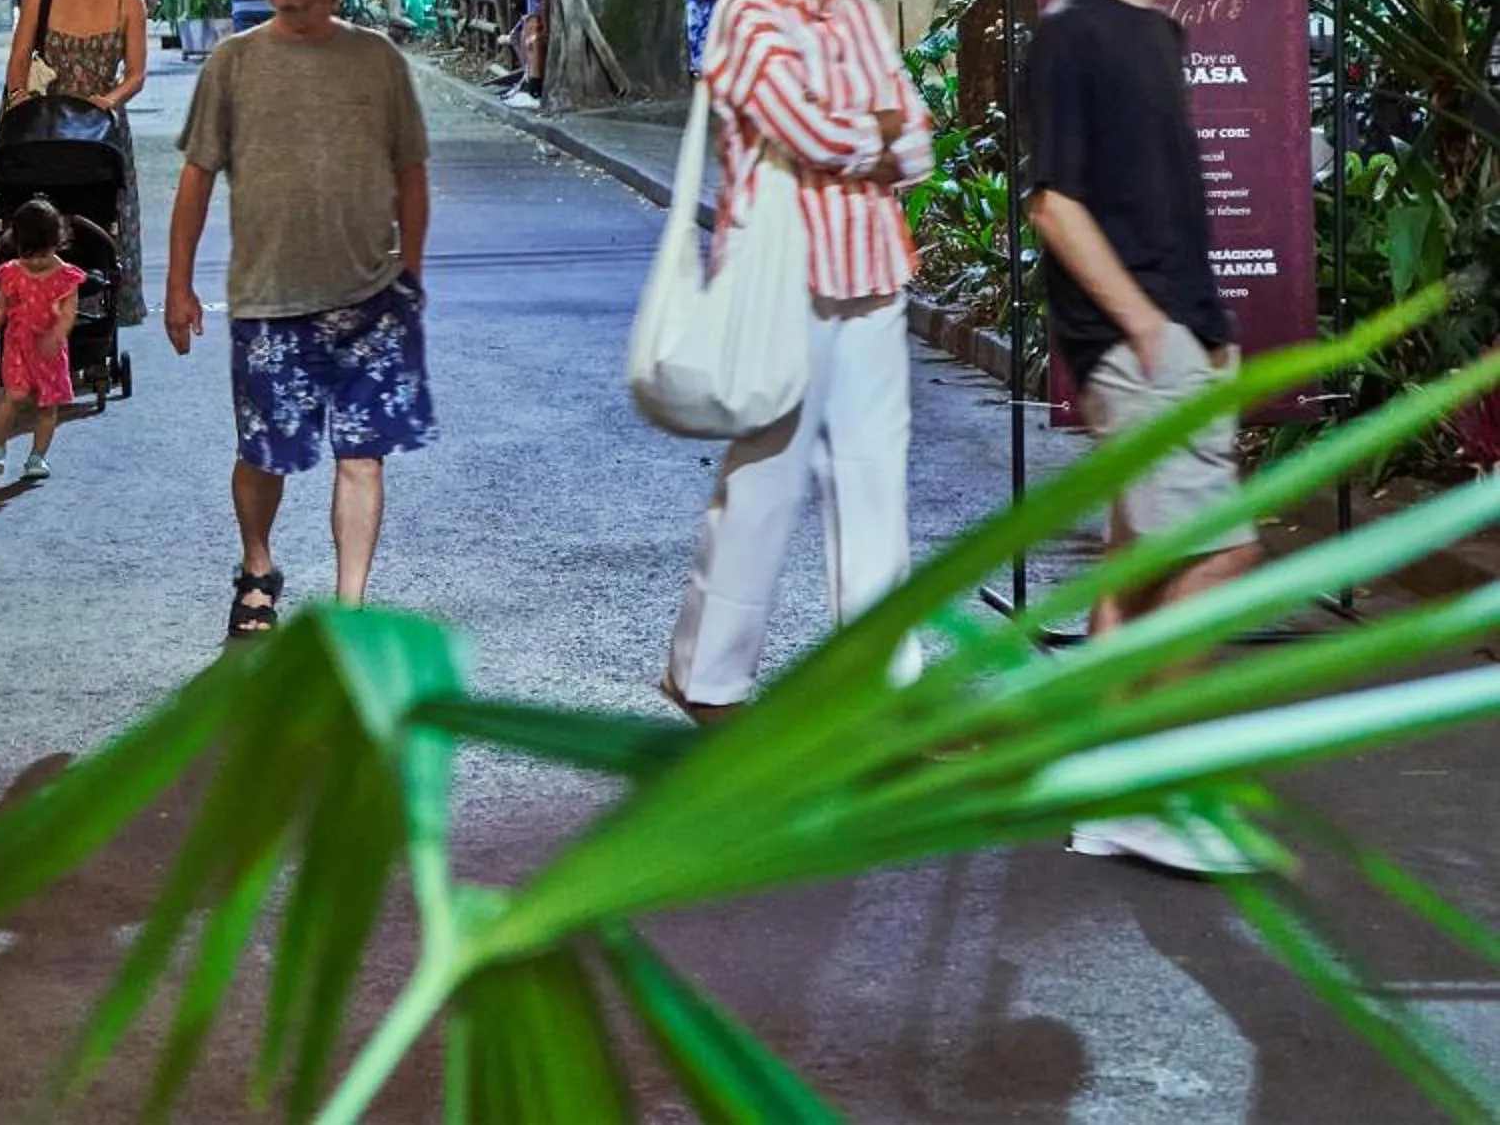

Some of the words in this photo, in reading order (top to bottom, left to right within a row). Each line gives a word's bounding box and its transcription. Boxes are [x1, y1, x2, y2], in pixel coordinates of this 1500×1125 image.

[1191, 52, 1216, 67] Day
[1219, 54, 1237, 65] en
[1219, 127, 1251, 138] con:
